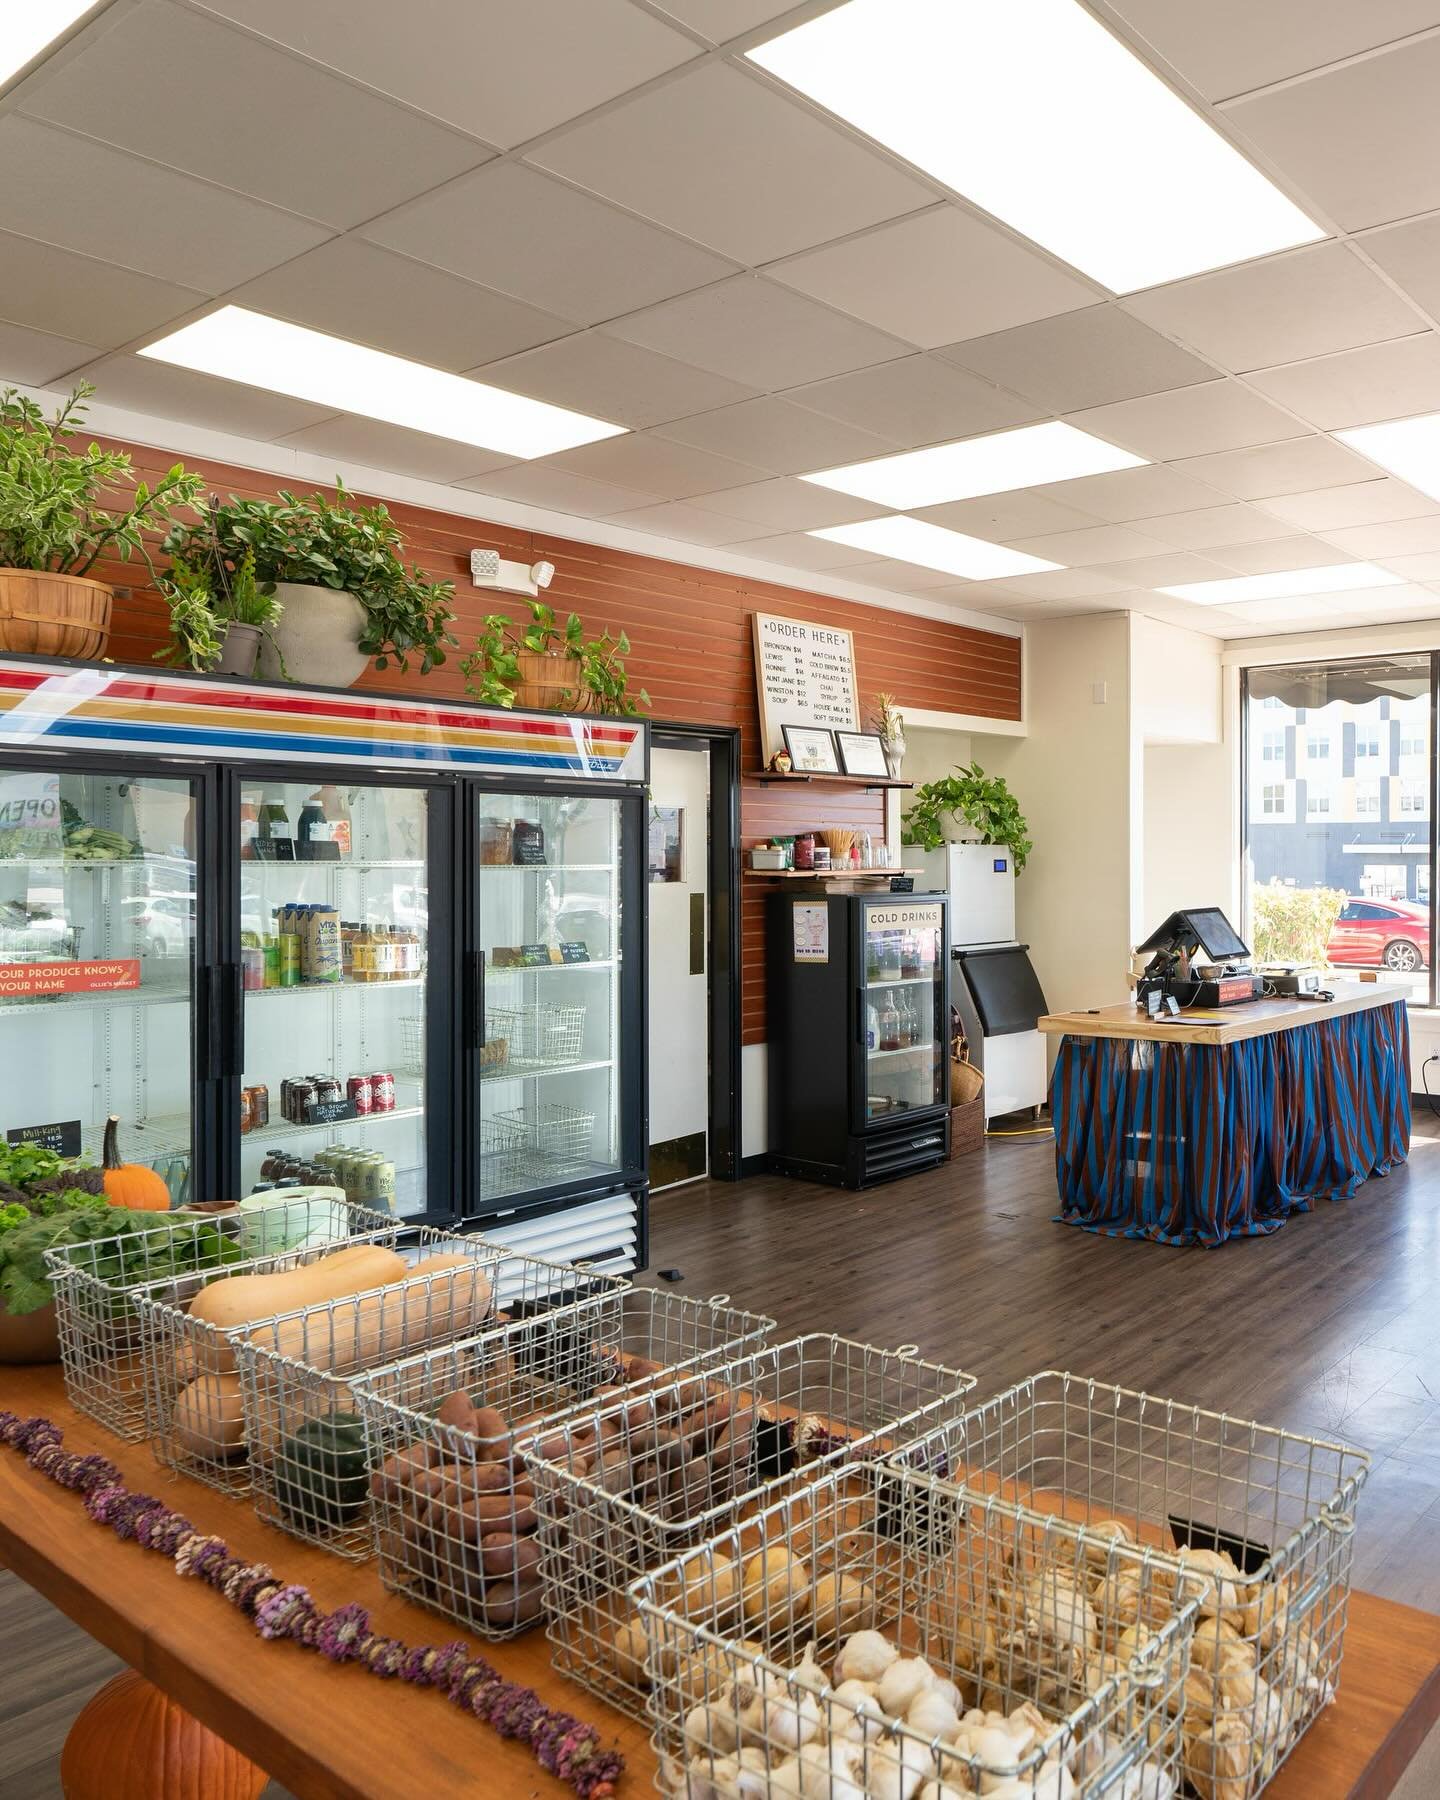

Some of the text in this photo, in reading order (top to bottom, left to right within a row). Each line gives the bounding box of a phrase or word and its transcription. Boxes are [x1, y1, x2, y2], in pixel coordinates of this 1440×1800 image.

[770, 622, 840, 645] ORDER HERE
[764, 641, 791, 652] BRONSON
[765, 653, 783, 661] LEWIS
[812, 651, 836, 661] MATCHA
[765, 664, 786, 672] RONNIE
[809, 661, 823, 669] COLD
[824, 664, 839, 672] BREW
[781, 677, 795, 685] JANE
[767, 686, 793, 695] WINSTON
[772, 696, 788, 704] SOUP
[821, 693, 838, 701] SYRUP
[814, 703, 831, 711] HOUSE
[870, 911, 937, 924] COLD DRINKS
[320, 921, 337, 929] VITA
[0, 965, 123, 979] OUR PRODUCE KNOWS
[0, 980, 65, 991] YOUR NAME
